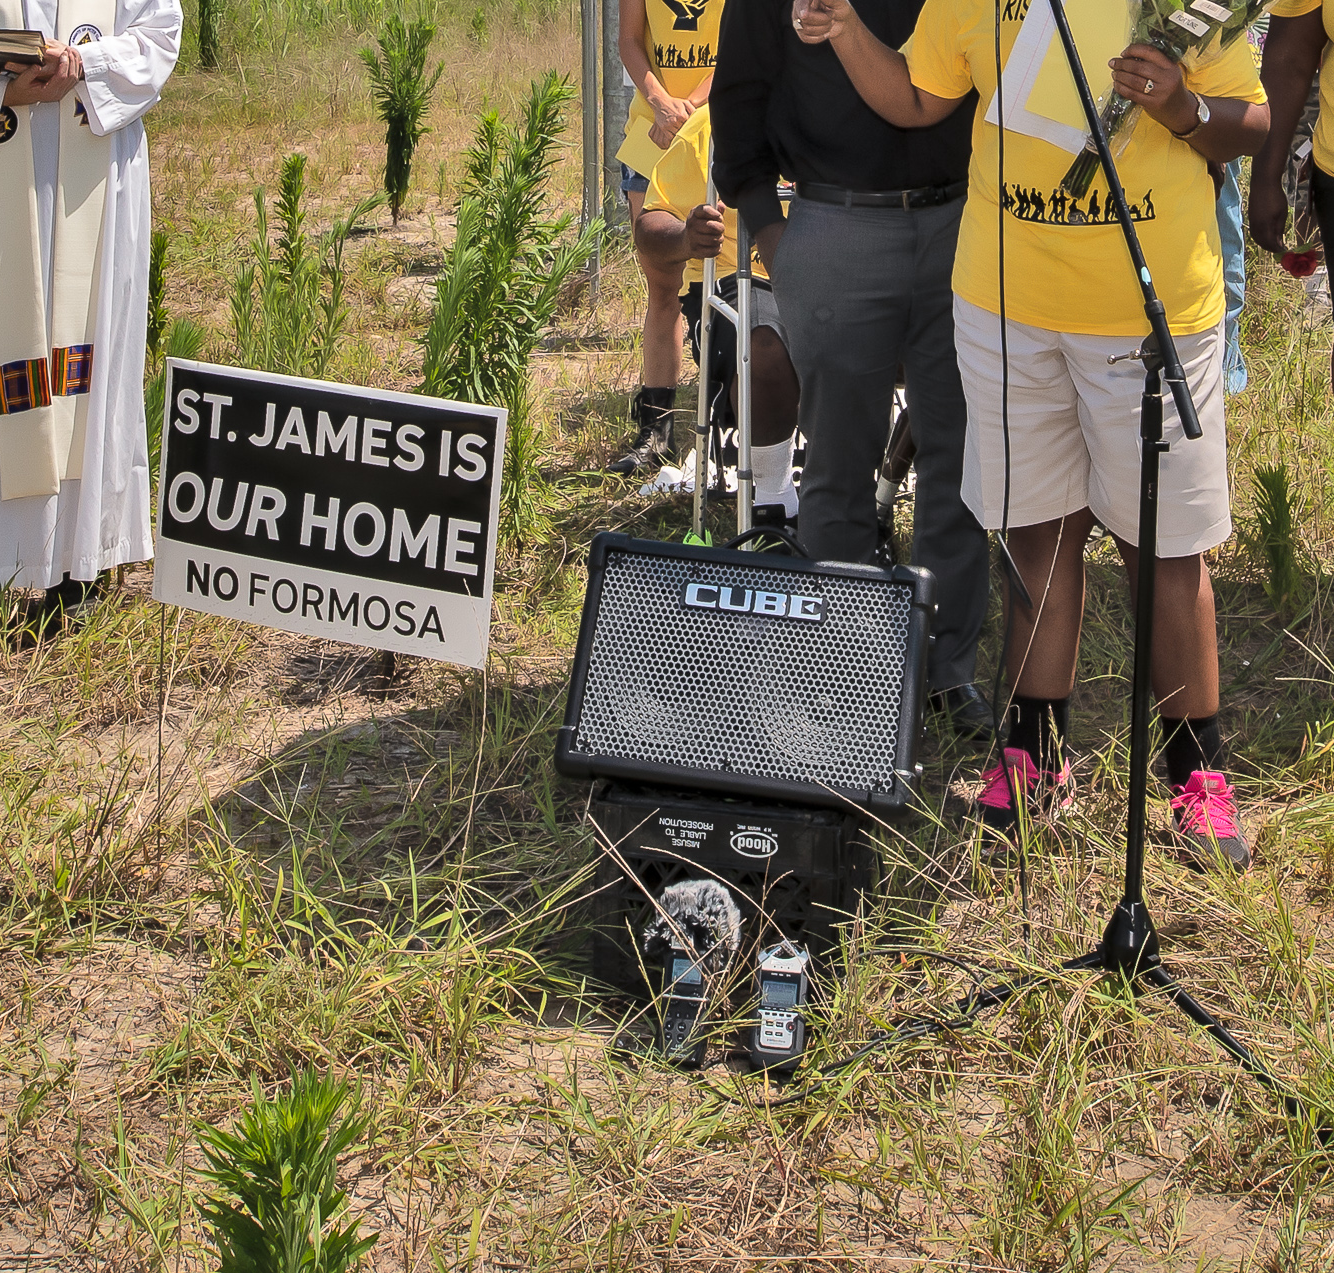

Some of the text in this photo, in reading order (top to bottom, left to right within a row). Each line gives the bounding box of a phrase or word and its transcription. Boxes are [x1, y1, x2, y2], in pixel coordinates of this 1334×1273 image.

[1175, 14, 1199, 30] FORTUNE
[174, 388, 487, 481] ST. JAMES IS
[168, 471, 482, 576] OUR HOME
[186, 559, 445, 643] NO FORMOSA
[685, 582, 823, 620] CUBE
[659, 818, 713, 830] PROSECUTION
[665, 828, 707, 840] LIABLE TO
[671, 838, 700, 848] MISUSE
